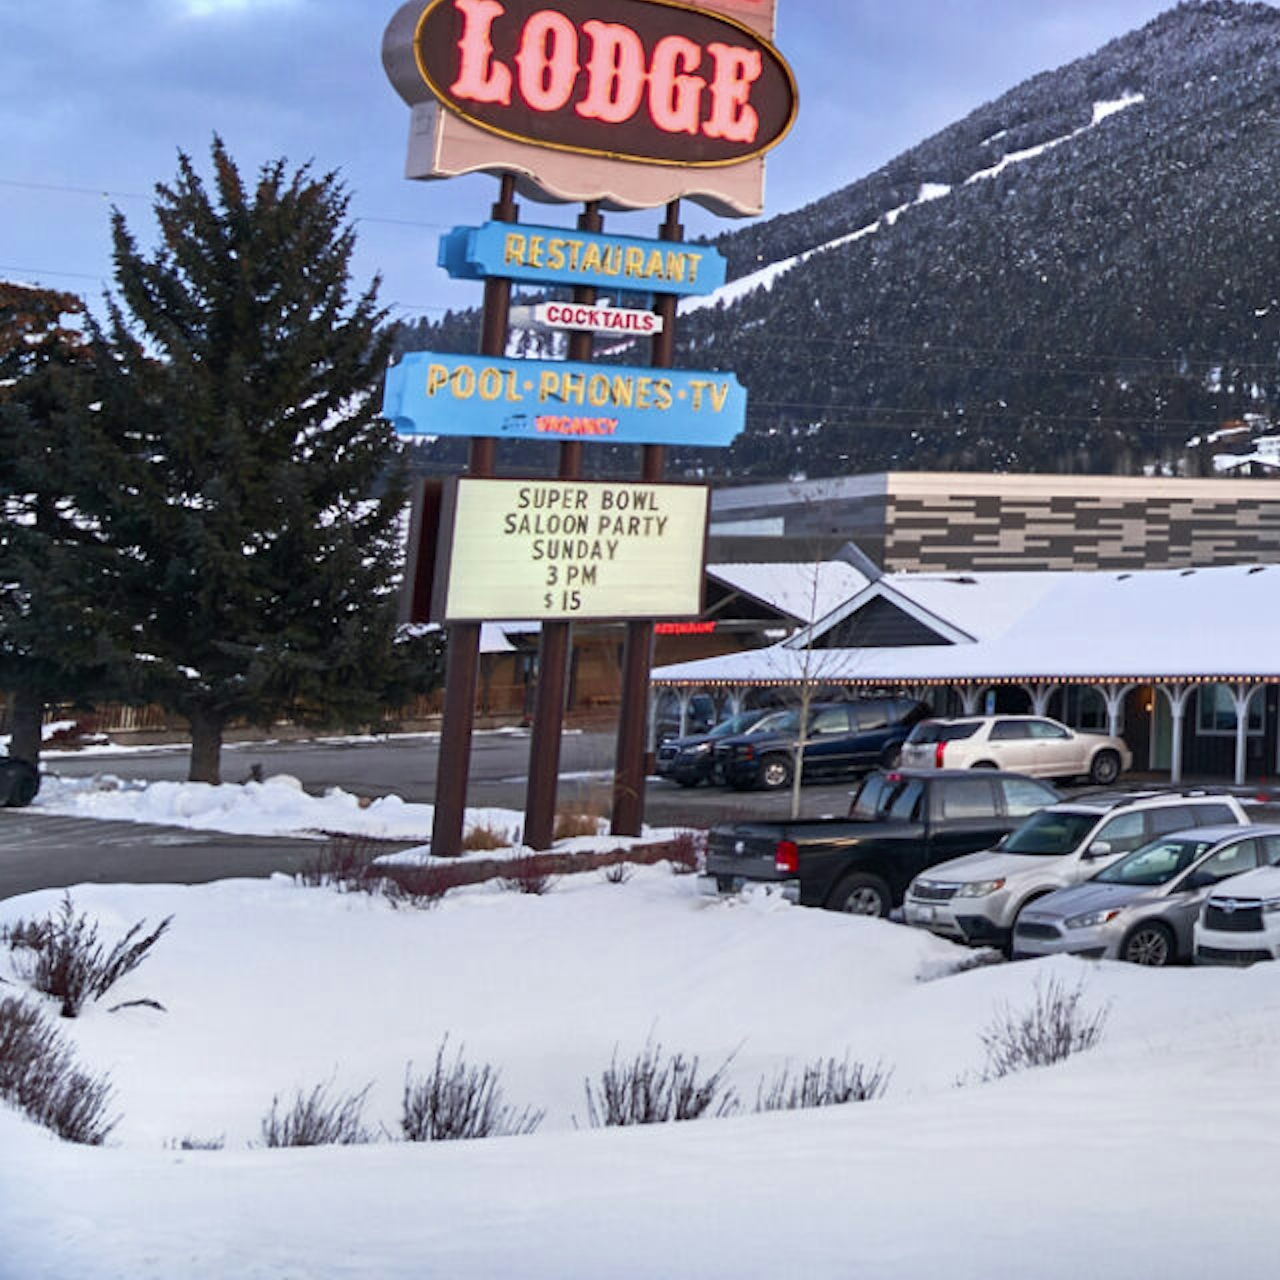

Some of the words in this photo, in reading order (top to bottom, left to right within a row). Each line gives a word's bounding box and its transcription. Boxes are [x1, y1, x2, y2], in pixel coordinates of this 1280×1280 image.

[504, 234, 702, 282] RESTAURANT
[546, 306, 654, 331] COCKTAILS
[426, 364, 523, 401] POOL
[538, 371, 672, 410] PHONES
[688, 381, 729, 413] TV
[535, 415, 619, 436] VACANCY
[518, 488, 588, 509] SUPER
[601, 490, 659, 511] BOWL
[504, 514, 588, 535] SALOON
[599, 516, 668, 537] PARTY
[532, 540, 619, 561] SUNDAY
[546, 566, 557, 586] 3
[566, 566, 597, 586] PM
